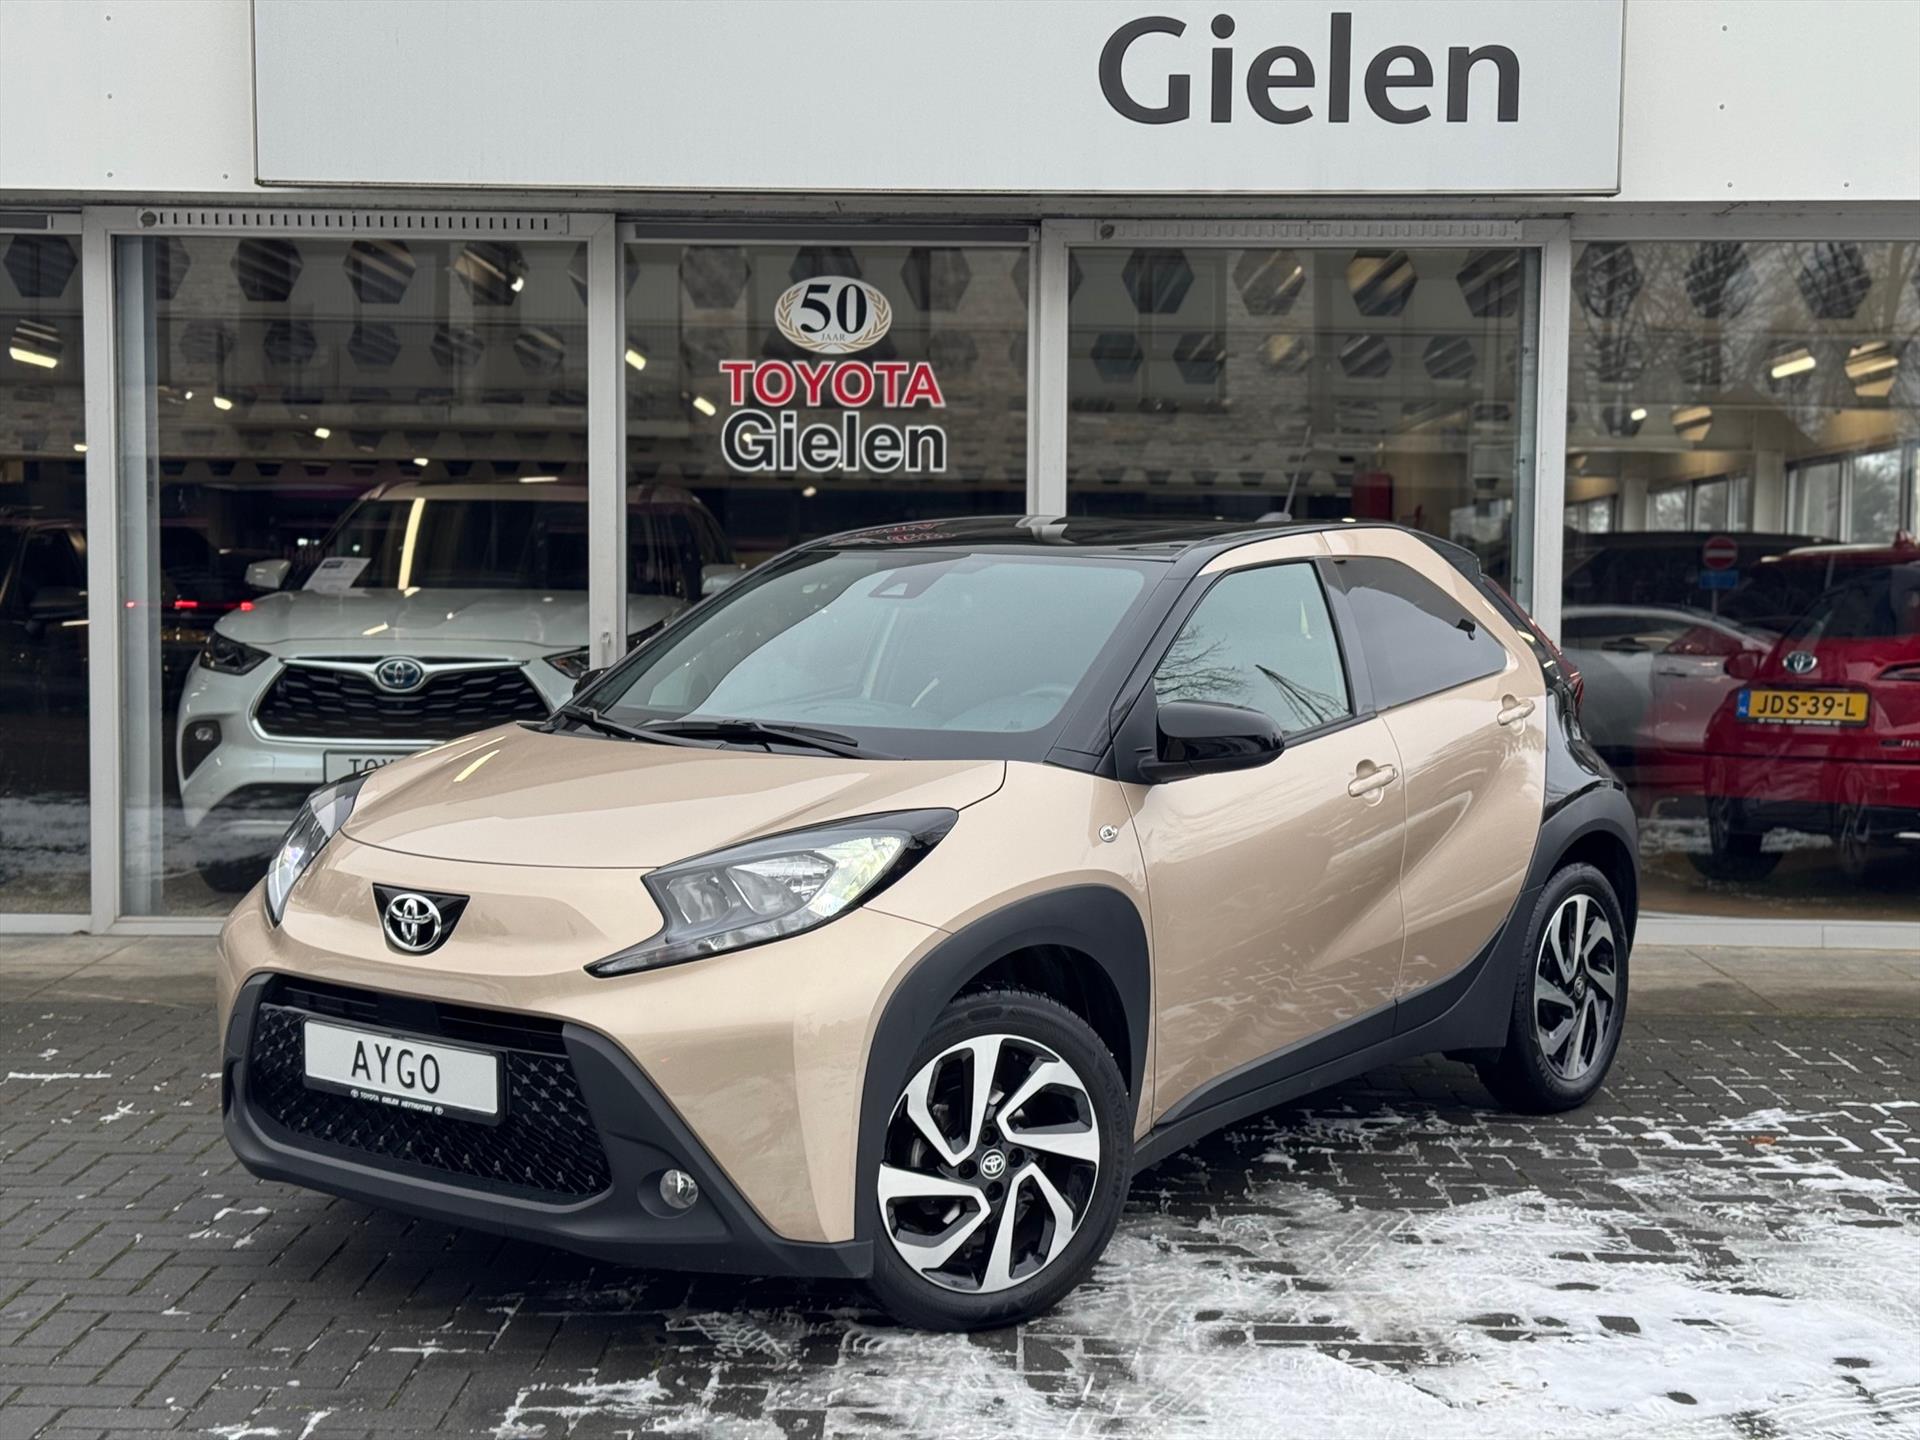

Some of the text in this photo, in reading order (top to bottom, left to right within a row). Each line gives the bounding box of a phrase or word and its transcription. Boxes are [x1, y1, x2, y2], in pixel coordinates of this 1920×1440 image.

[1099, 12, 1519, 124] Gielen
[800, 284, 867, 334] 50
[820, 333, 846, 342] JAAR
[719, 359, 946, 407] TOYOTA
[721, 409, 947, 472] Gielen
[1757, 695, 1856, 717] JDS-39-L
[351, 1040, 441, 1094] AYGO
